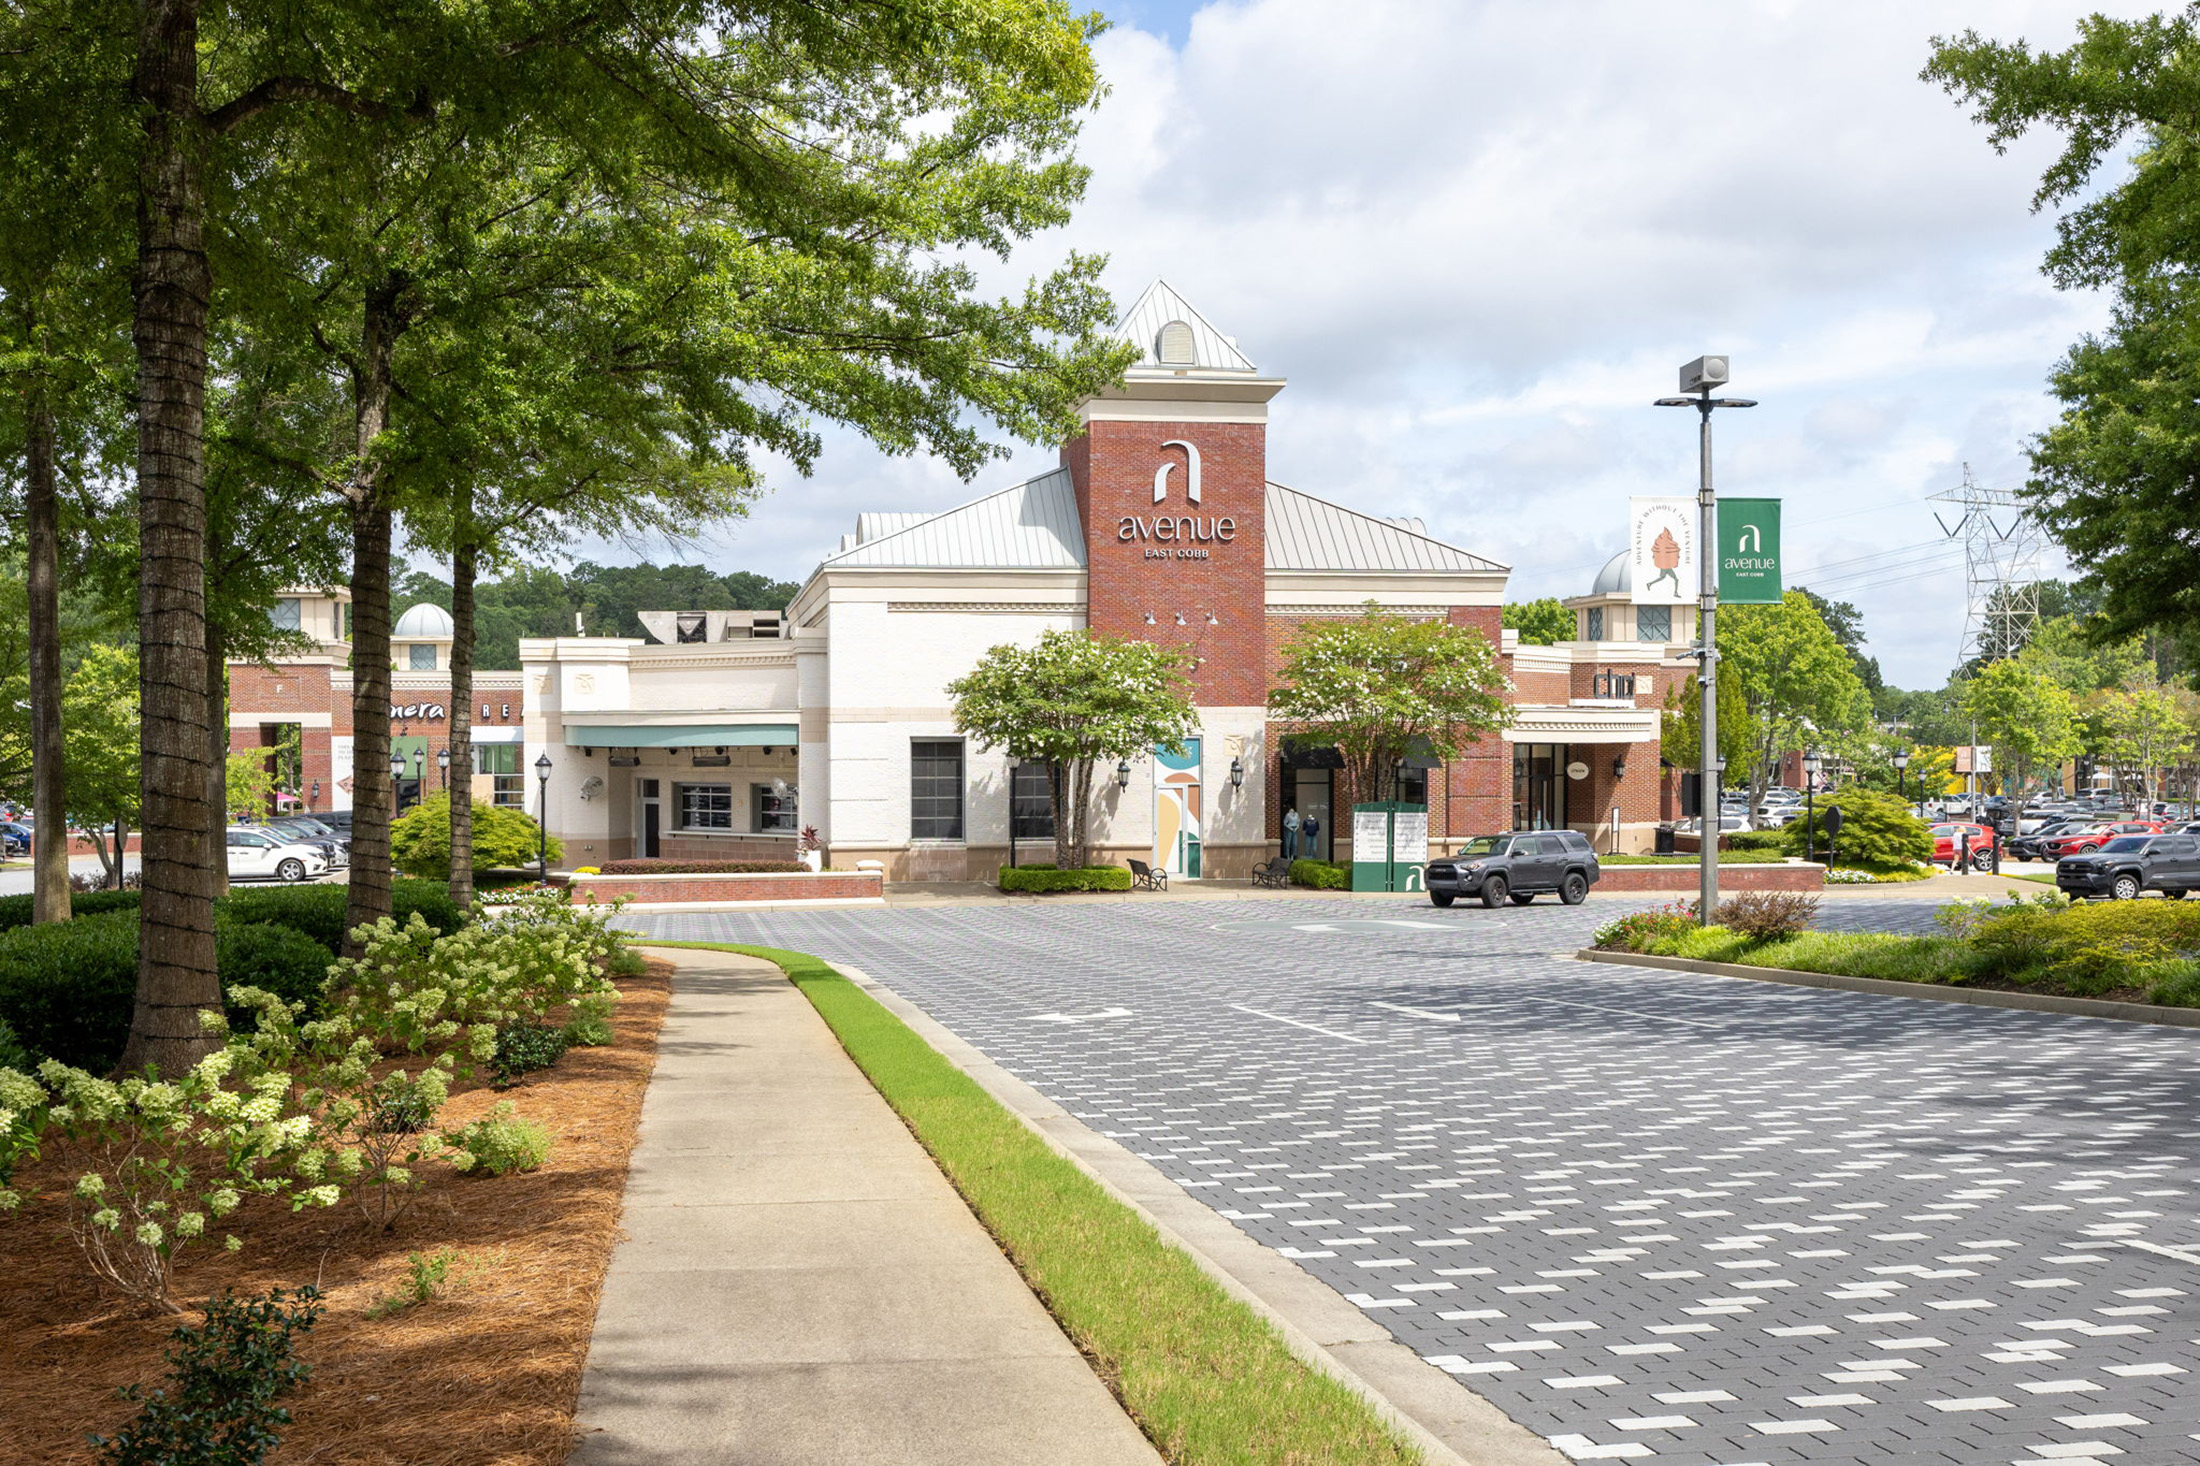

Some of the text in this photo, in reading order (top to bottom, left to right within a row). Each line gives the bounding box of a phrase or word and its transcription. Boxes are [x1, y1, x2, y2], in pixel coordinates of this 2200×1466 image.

[1642, 504, 1677, 518] WITHOUT
[1678, 513, 1688, 526] THE
[1118, 516, 1236, 541] avenue
[1145, 549, 1209, 558] EAST COBB
[1724, 557, 1775, 569] avenue
[276, 684, 283, 694] F
[390, 702, 446, 719] nera
